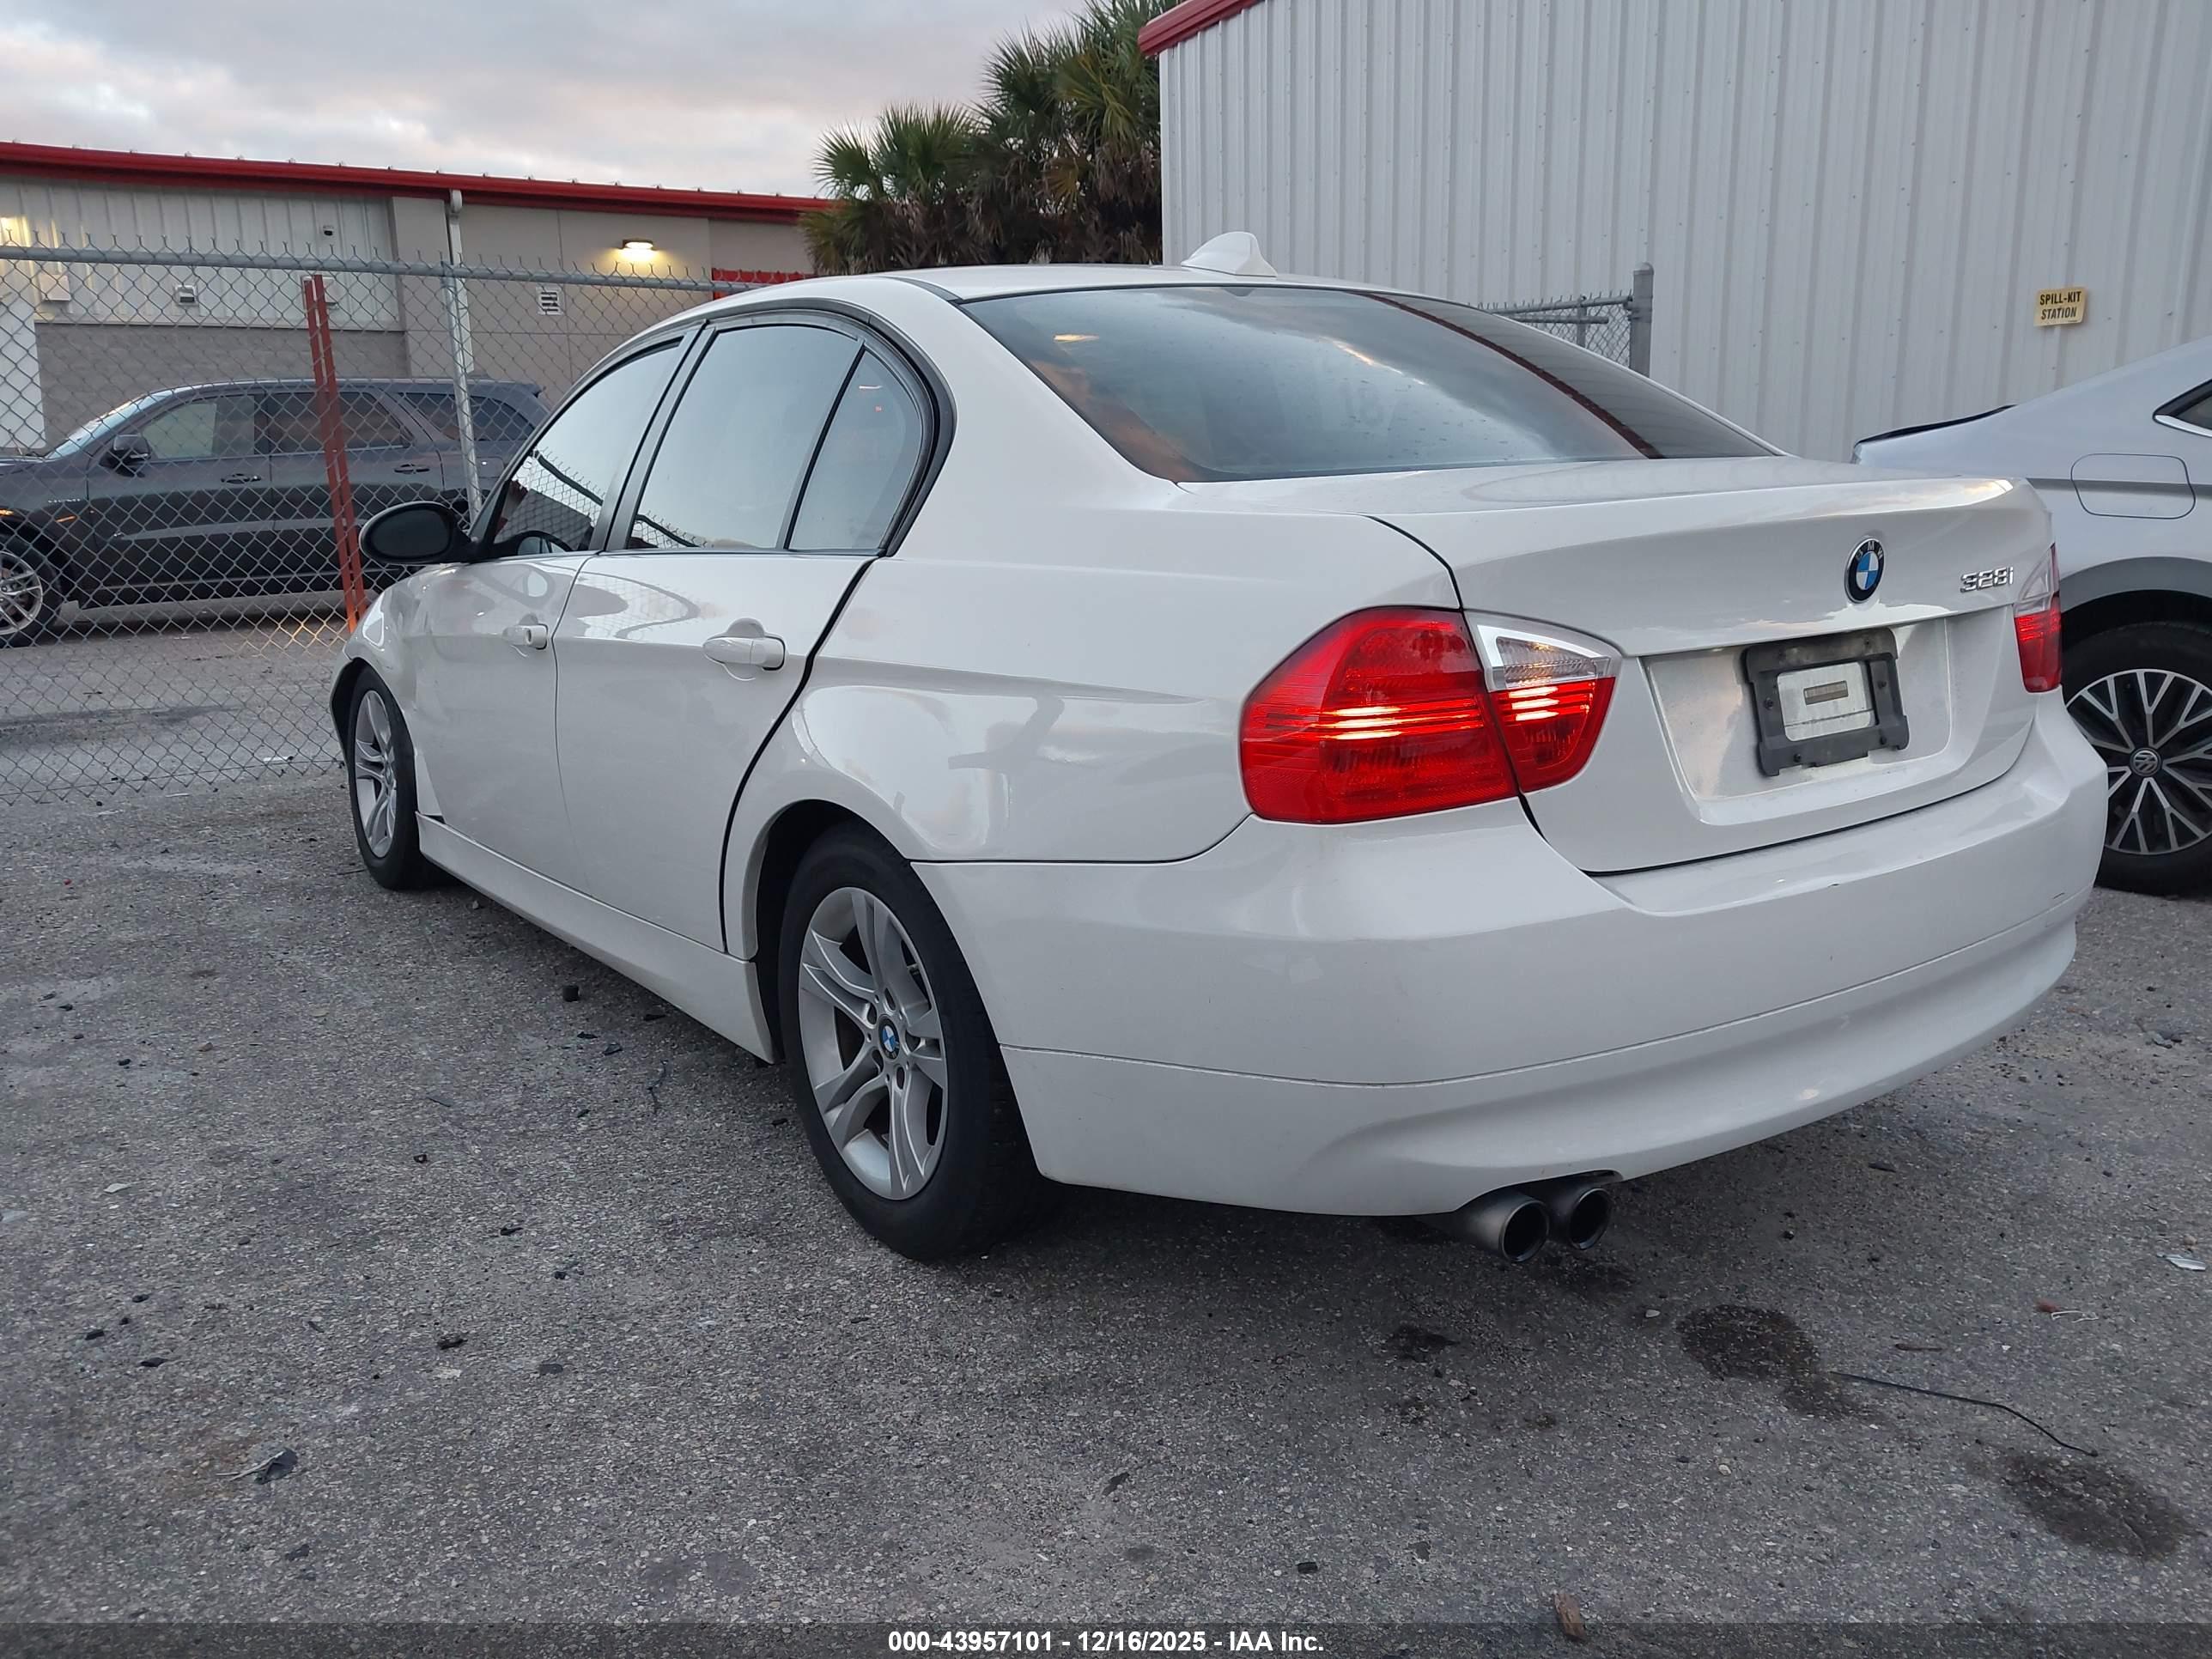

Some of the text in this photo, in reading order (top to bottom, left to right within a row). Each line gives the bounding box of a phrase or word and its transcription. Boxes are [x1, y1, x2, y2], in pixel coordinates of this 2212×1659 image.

[2039, 291, 2081, 306] SPILL-KIT
[2041, 307, 2077, 320] STATION
[1960, 566, 2014, 592] 328i
